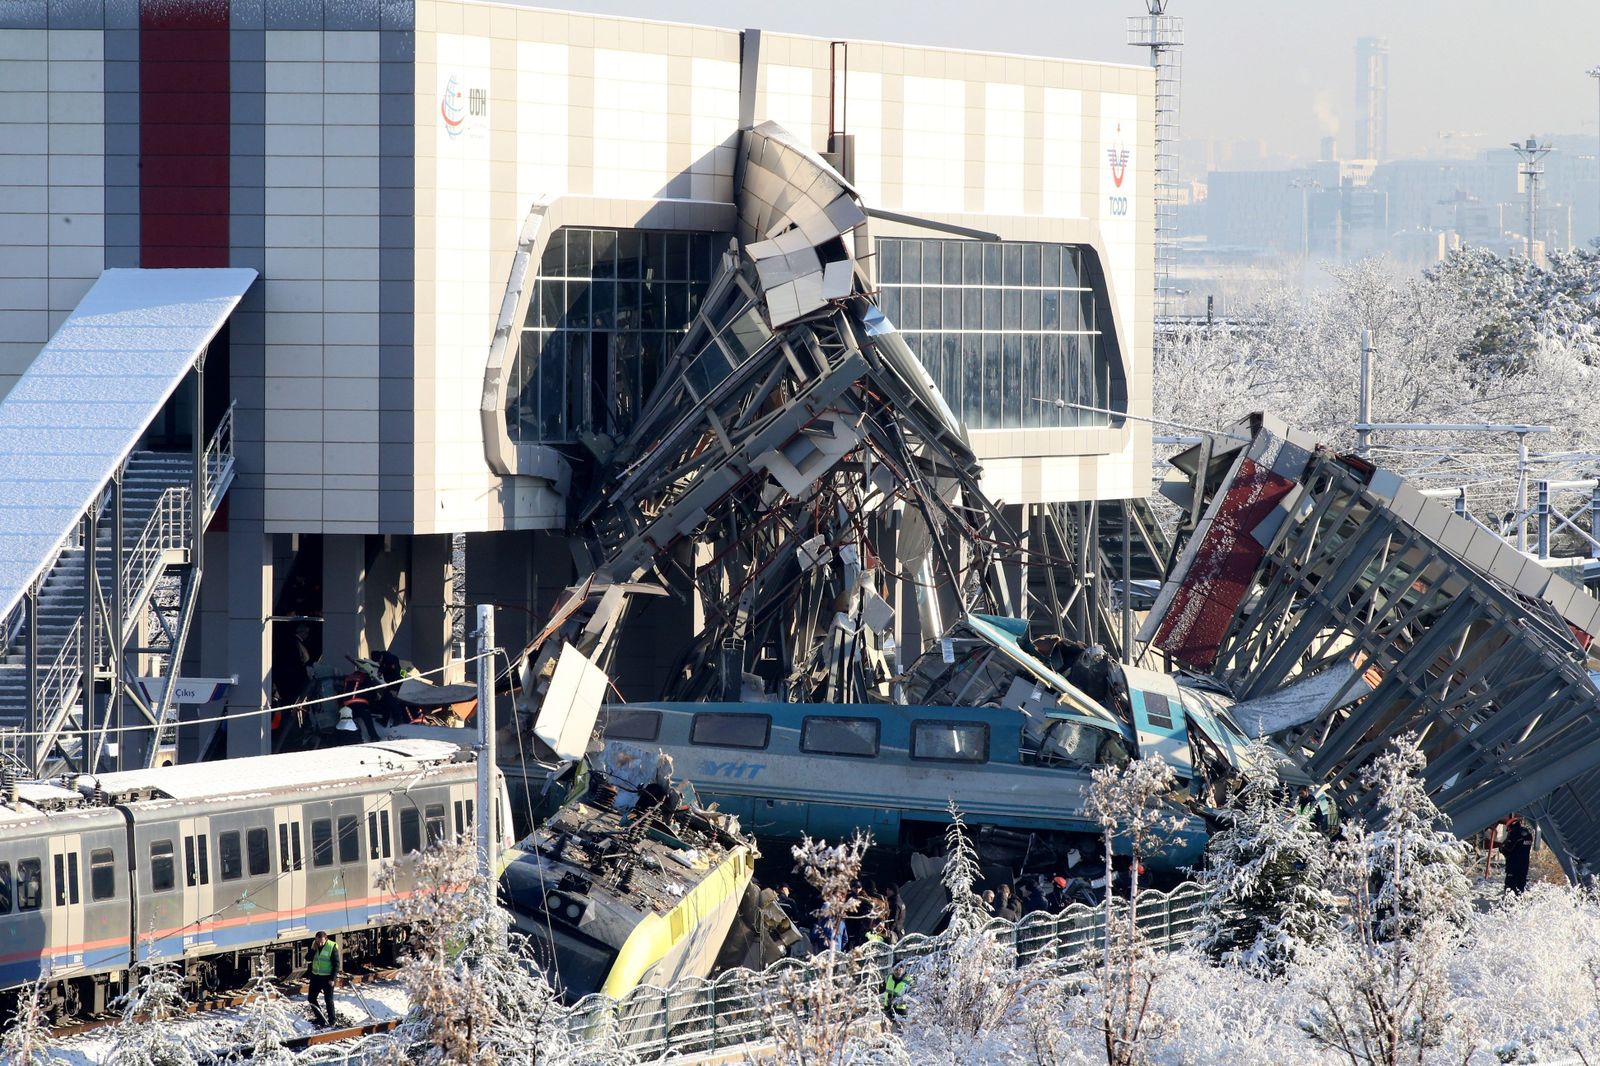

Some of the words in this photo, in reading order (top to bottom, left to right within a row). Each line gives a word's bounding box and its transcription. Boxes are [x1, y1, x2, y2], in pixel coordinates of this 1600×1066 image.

[469, 88, 487, 117] UDH
[1109, 196, 1128, 216] TCDD
[175, 688, 196, 698] Çıkış
[702, 760, 768, 780] YHT
